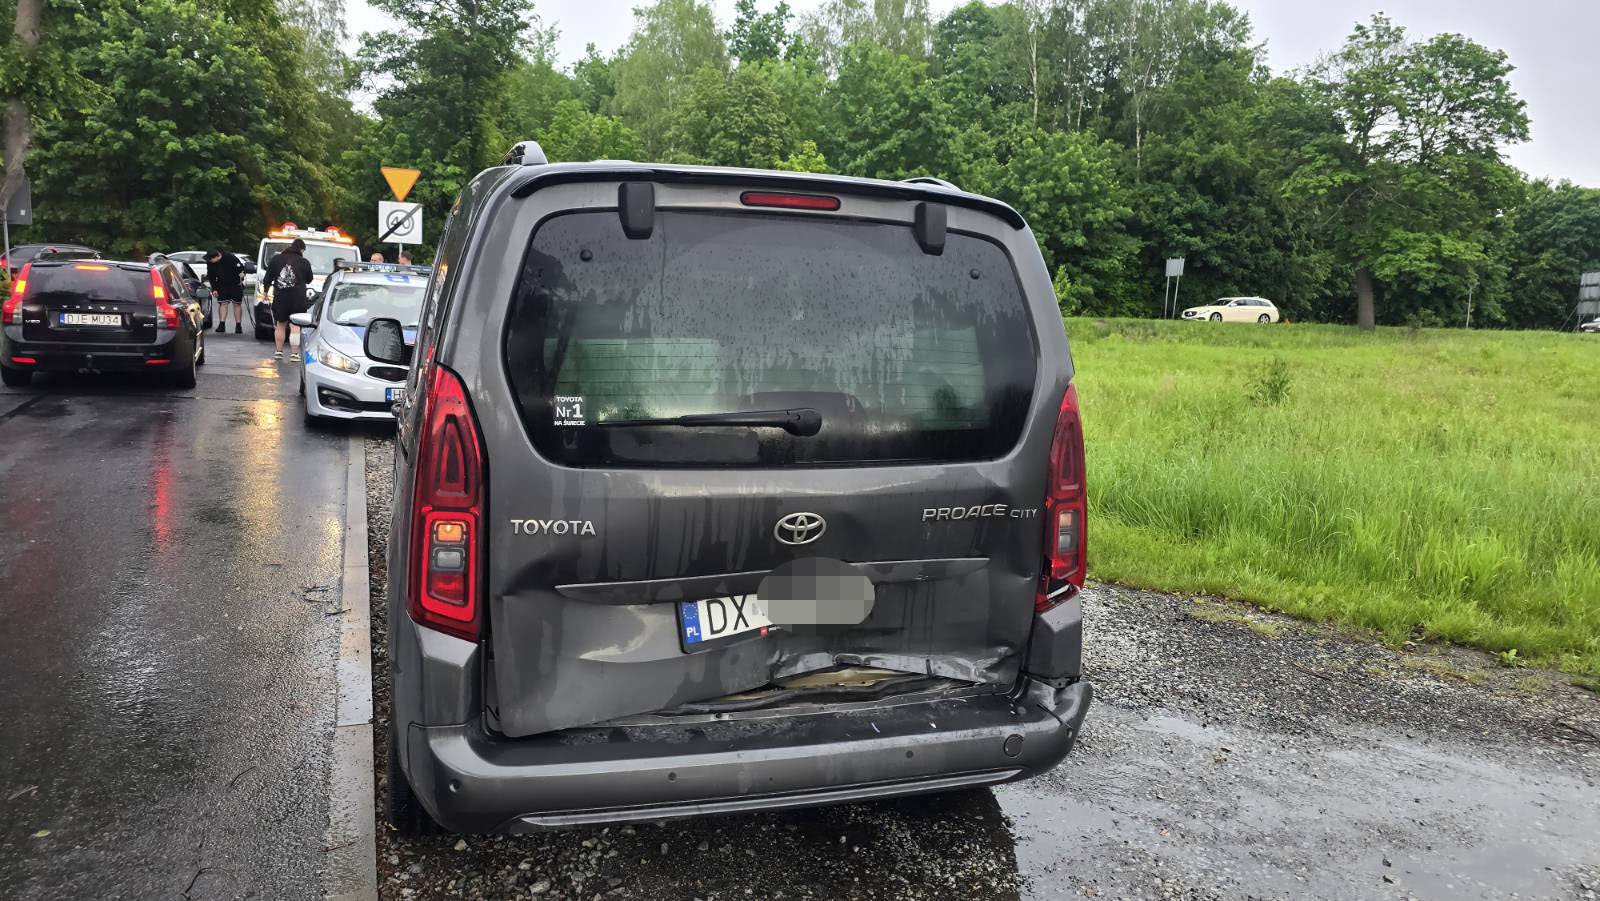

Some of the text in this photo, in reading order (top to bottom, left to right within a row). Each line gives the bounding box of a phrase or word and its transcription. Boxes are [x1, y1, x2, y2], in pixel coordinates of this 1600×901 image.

[67, 314, 87, 324] DJE
[556, 403, 584, 418] Nr 1
[921, 503, 1038, 521] PROACE CITY
[510, 519, 596, 536] TOYOTA
[706, 593, 750, 635] DX
[686, 626, 700, 638] PL
